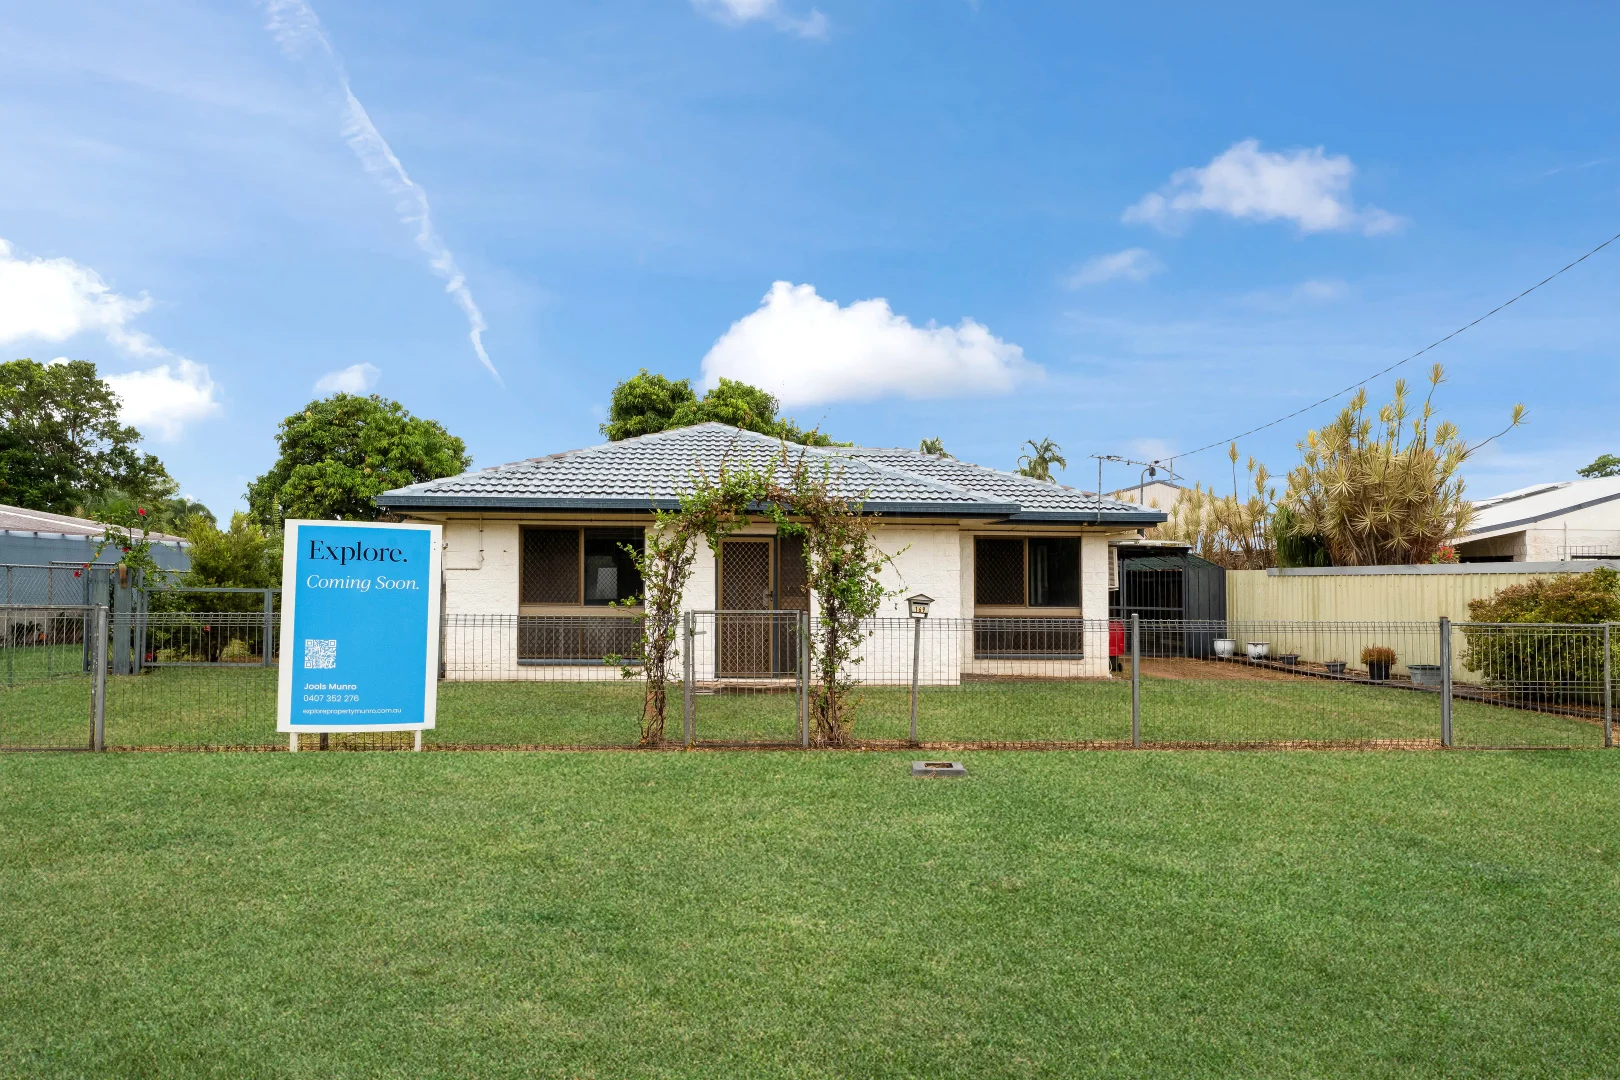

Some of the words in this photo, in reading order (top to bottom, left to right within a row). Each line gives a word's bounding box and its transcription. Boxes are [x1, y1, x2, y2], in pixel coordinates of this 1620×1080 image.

[309, 539, 408, 565] Explore.
[306, 574, 371, 593] Coming
[375, 575, 419, 590] Soon.
[303, 683, 327, 691] Jools
[328, 682, 357, 690] Munro
[303, 694, 324, 702] 0407
[326, 694, 342, 702] 352
[344, 694, 360, 702] 276
[302, 707, 402, 715] explorepropertymunro.com.au
